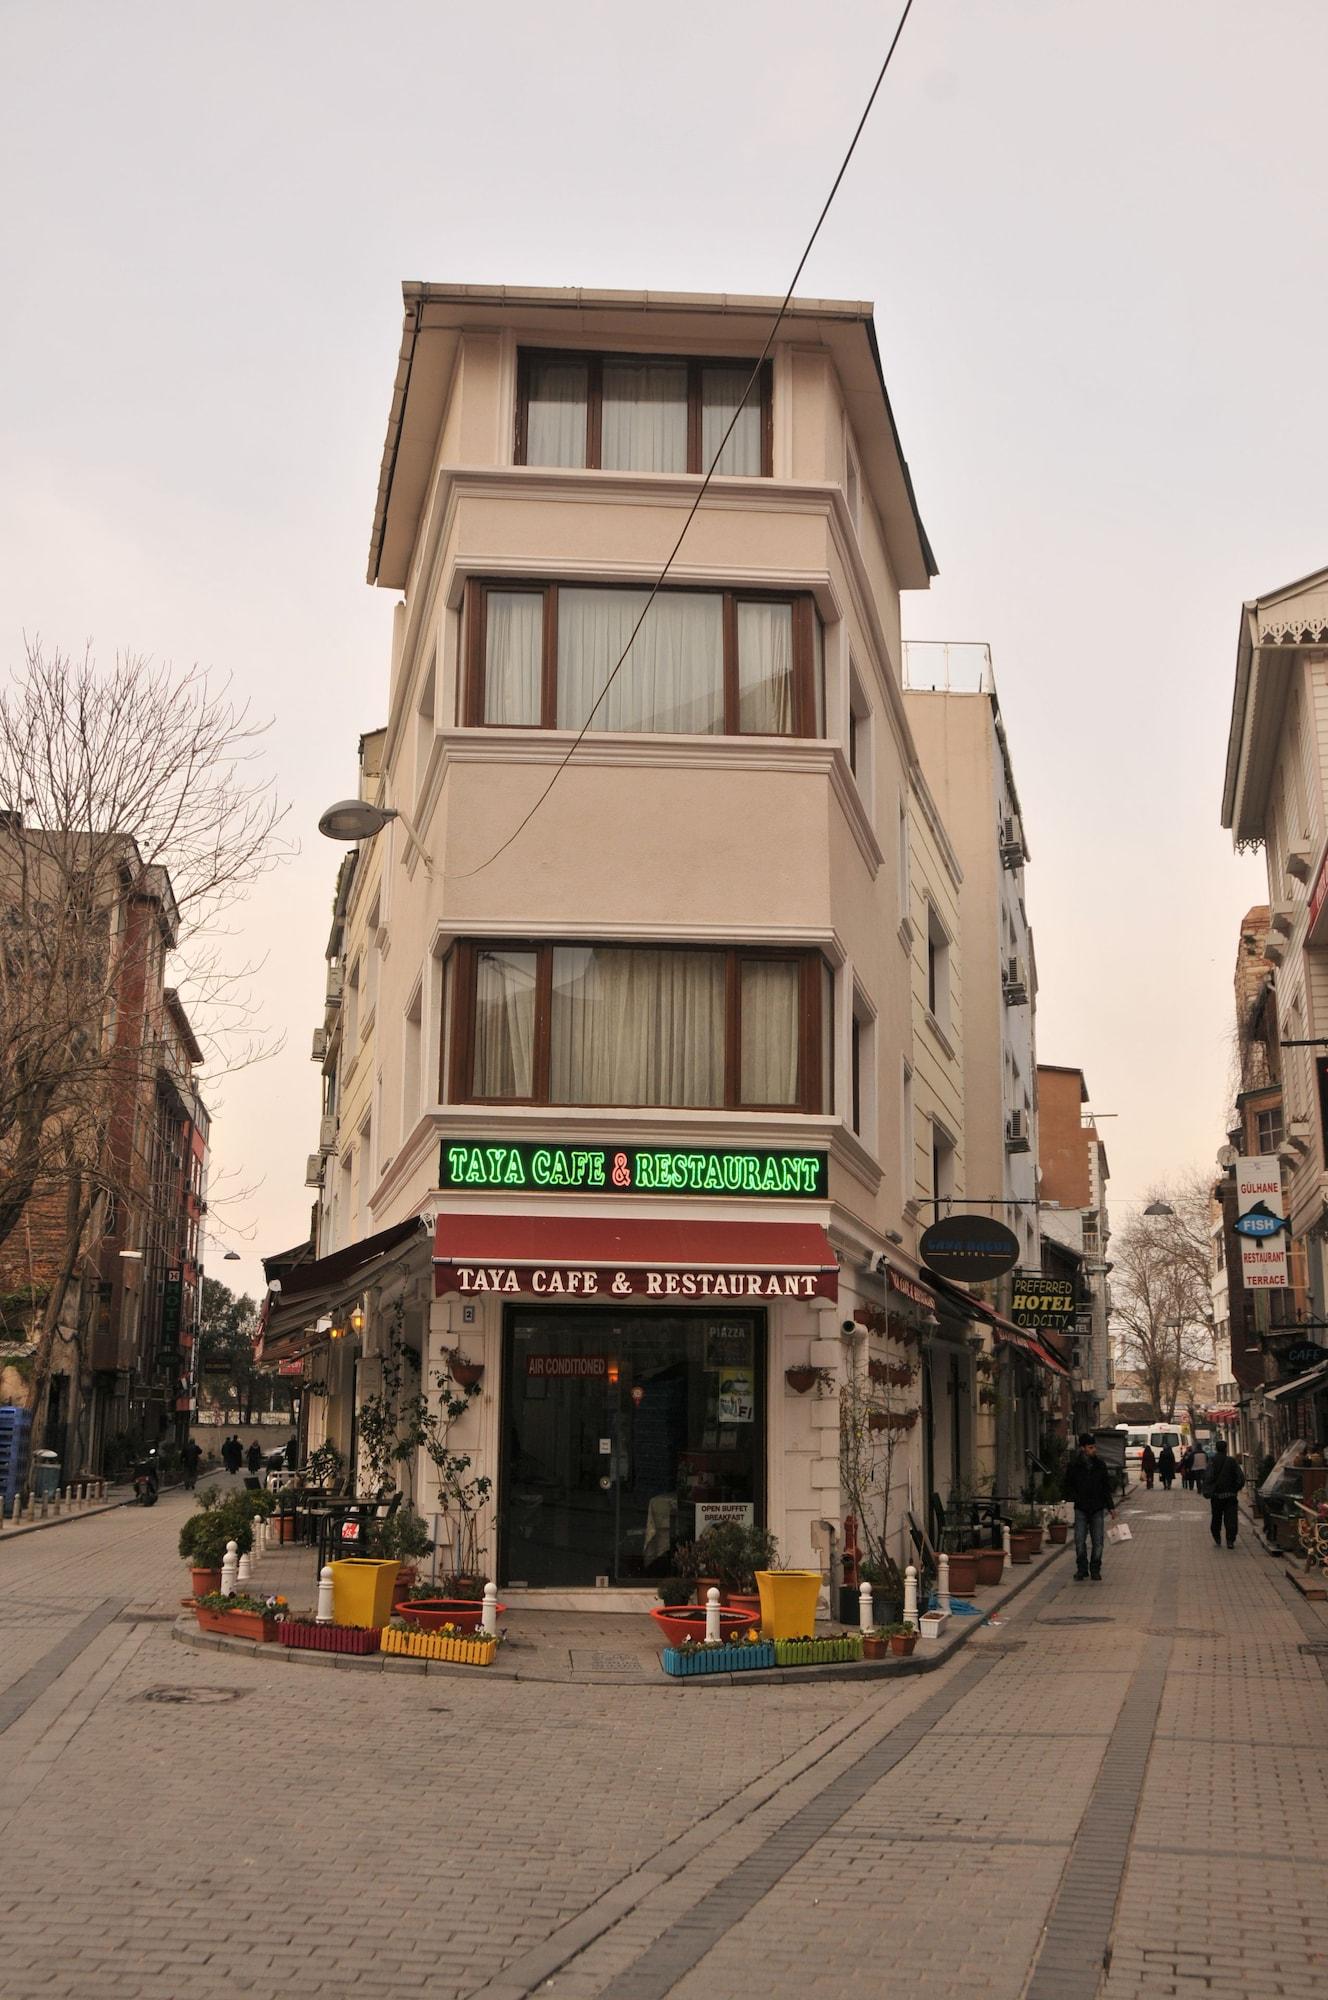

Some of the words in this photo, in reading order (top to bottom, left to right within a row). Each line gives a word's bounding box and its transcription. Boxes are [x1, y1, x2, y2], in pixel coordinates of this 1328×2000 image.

[448, 1148, 526, 1184] TAYA
[532, 1150, 605, 1187] CAFE
[612, 1152, 631, 1187] &
[635, 1153, 820, 1193] RESTAURANT
[1243, 1219, 1275, 1231] FISH
[1243, 1251, 1285, 1264] RESTAURANT
[456, 1268, 521, 1293] TAYA
[532, 1269, 599, 1294] CAFE
[611, 1271, 632, 1294] &
[646, 1272, 818, 1296] RESTAURANT
[1014, 1279, 1073, 1295] PREFERRED
[1246, 1275, 1286, 1286] TERRACE
[1012, 1295, 1075, 1312] HOTEL
[165, 1282, 180, 1345] HOTEL
[466, 1310, 472, 1318] 2
[1017, 1313, 1069, 1327] OLDCITY
[709, 1327, 745, 1338] PIAZZA
[529, 1358, 544, 1375] AIR
[545, 1358, 606, 1375] CONDITIONED
